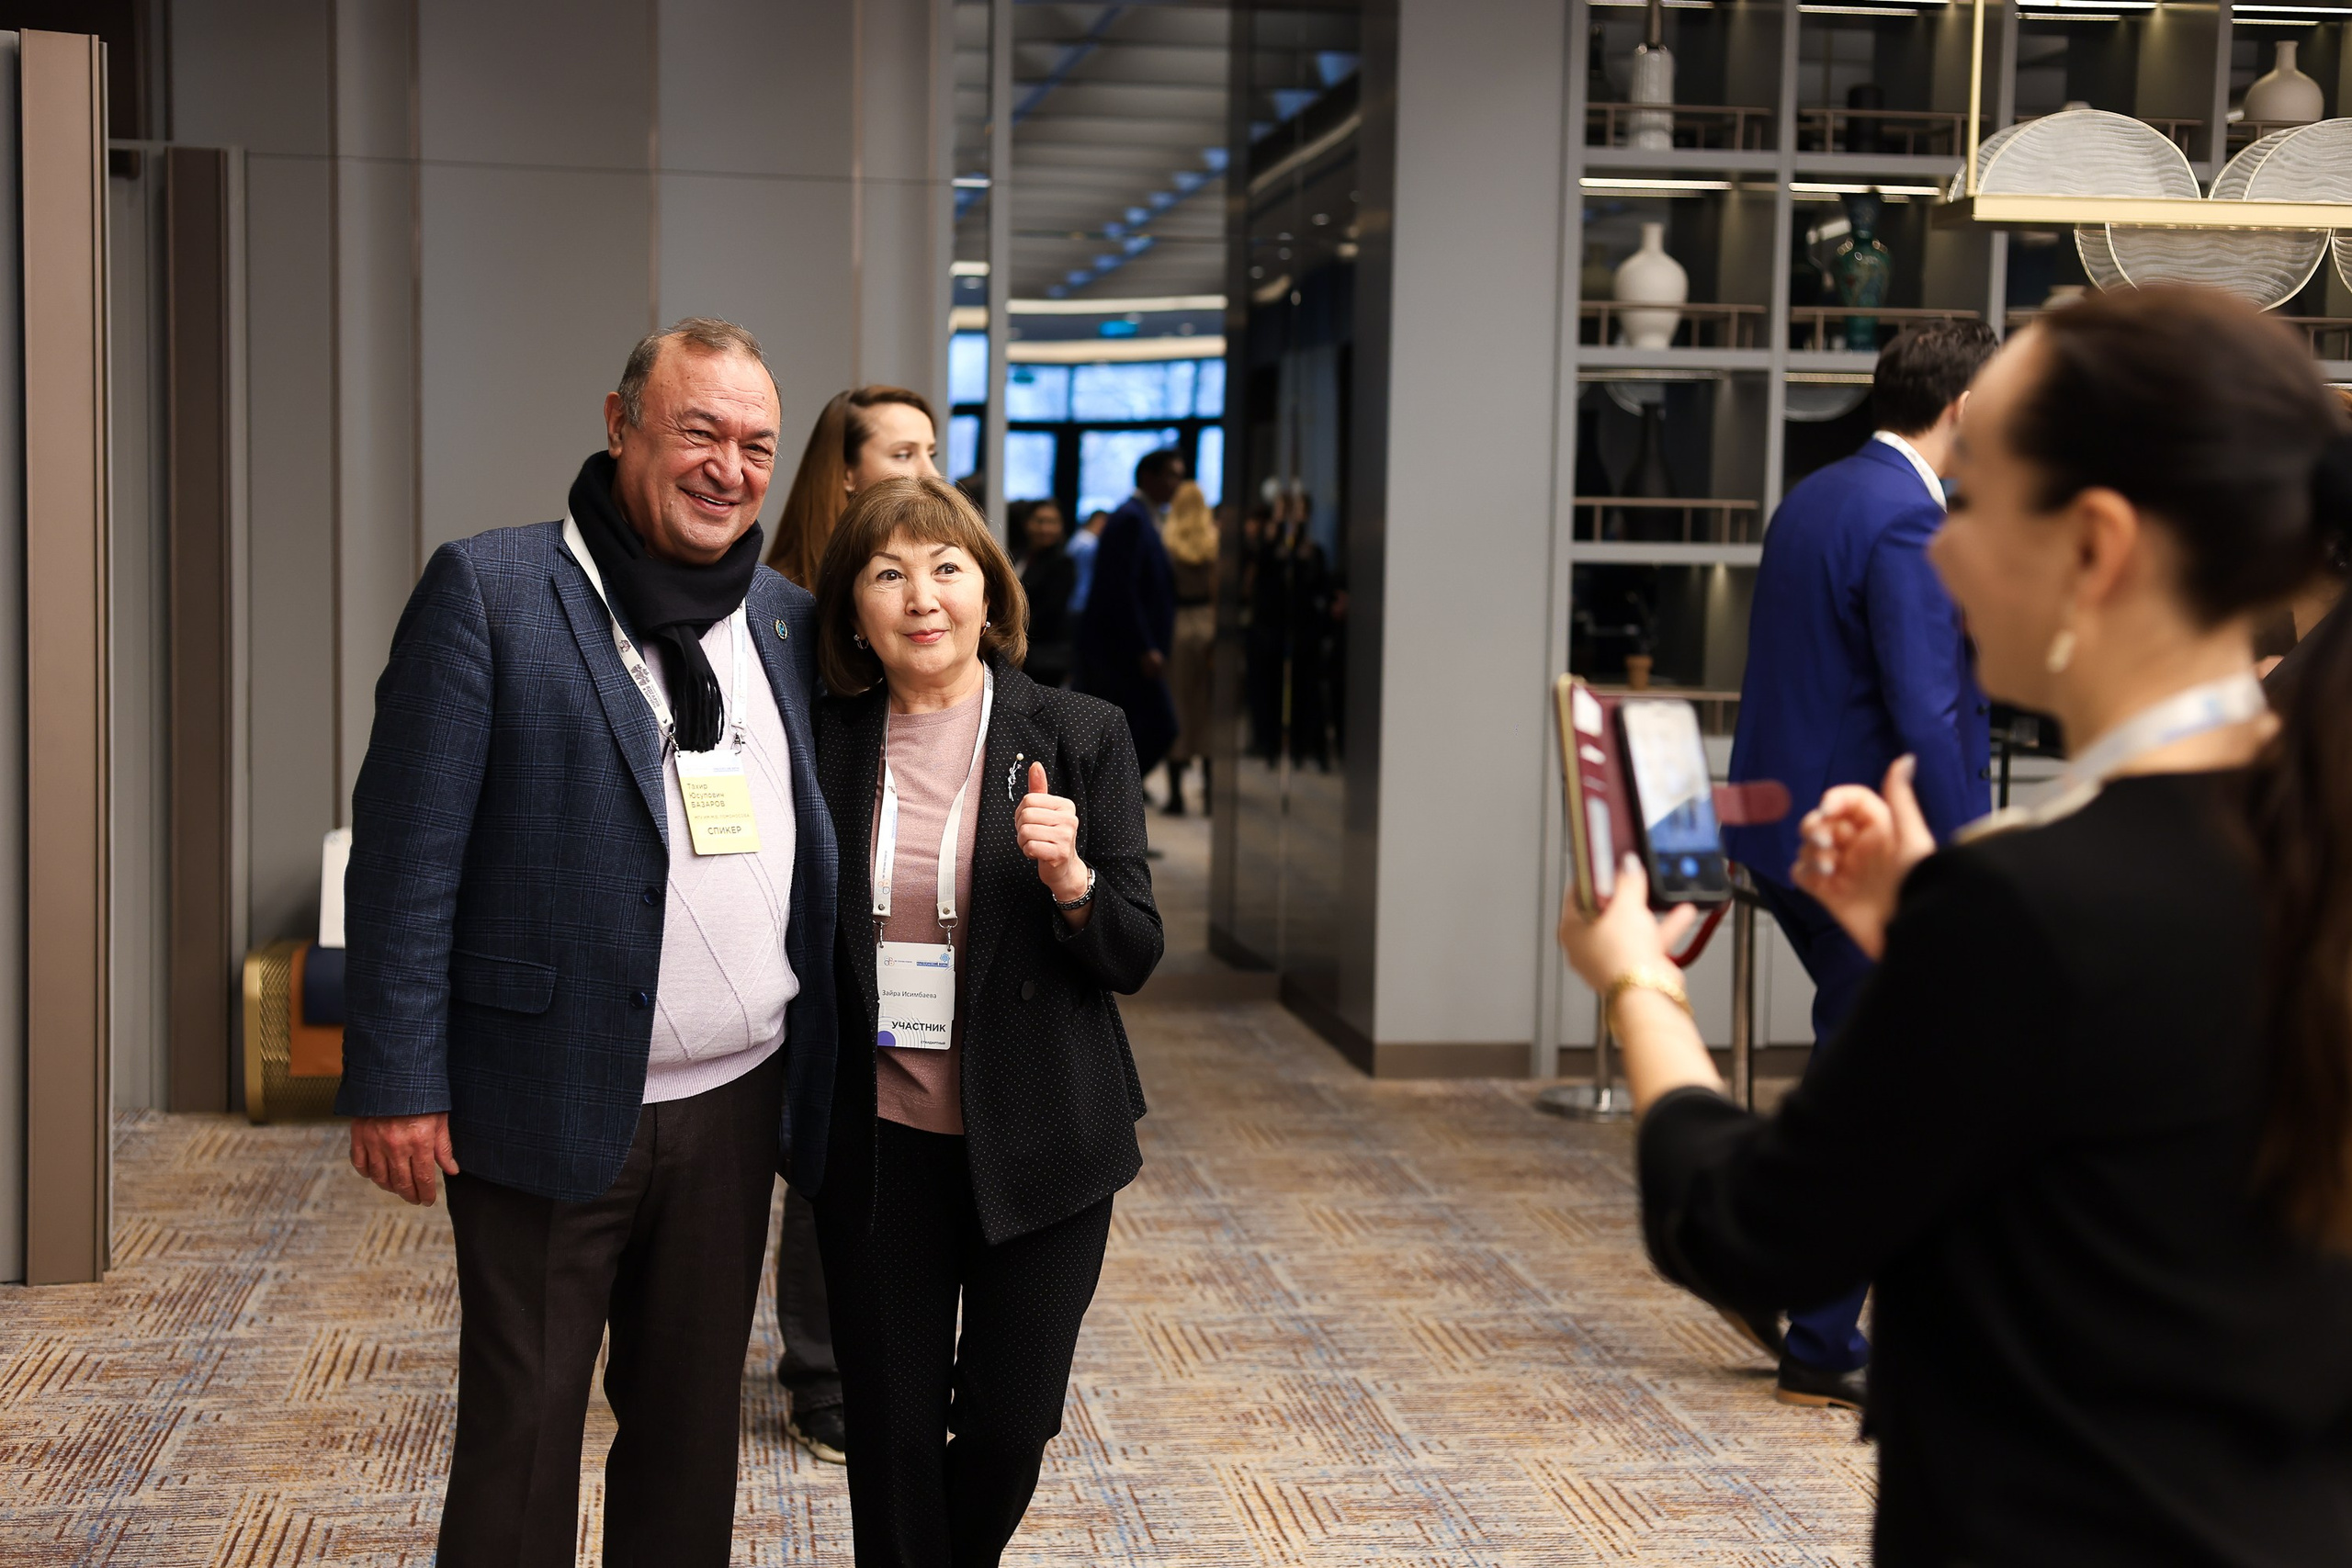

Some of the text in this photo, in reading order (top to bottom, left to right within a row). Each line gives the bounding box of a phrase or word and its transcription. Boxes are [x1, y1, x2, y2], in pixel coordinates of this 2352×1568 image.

[689, 792, 725, 800] Юсупович
[691, 800, 726, 808] БАЗАРОВ
[707, 826, 741, 835] СПИКЕР
[901, 990, 937, 998] Исимбаева
[891, 1021, 946, 1032] УЧАСТНИК
